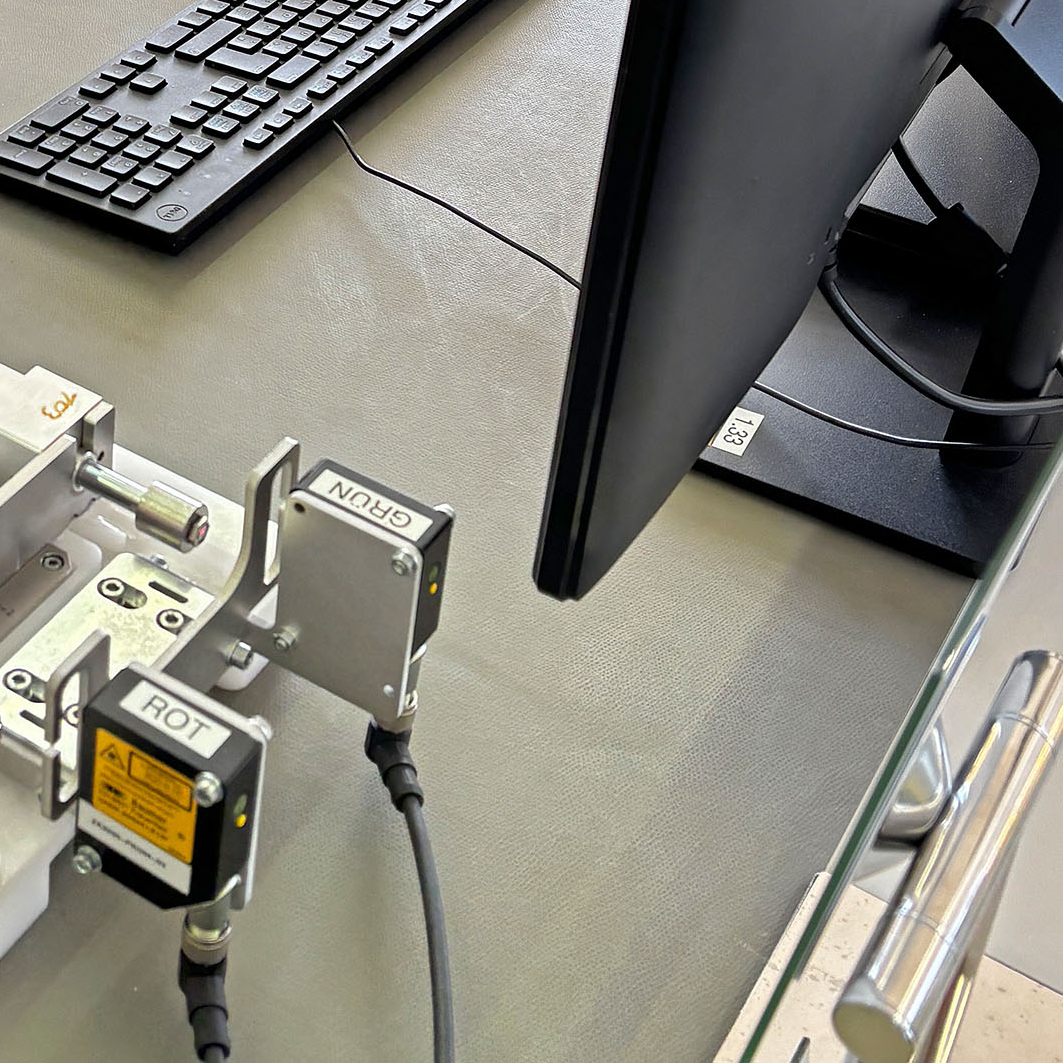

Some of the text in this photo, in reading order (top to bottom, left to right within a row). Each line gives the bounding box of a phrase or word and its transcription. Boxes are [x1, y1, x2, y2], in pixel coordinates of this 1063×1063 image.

[723, 417, 754, 446] 1.33
[328, 481, 412, 528] GRÜN
[141, 694, 211, 741] ROT
